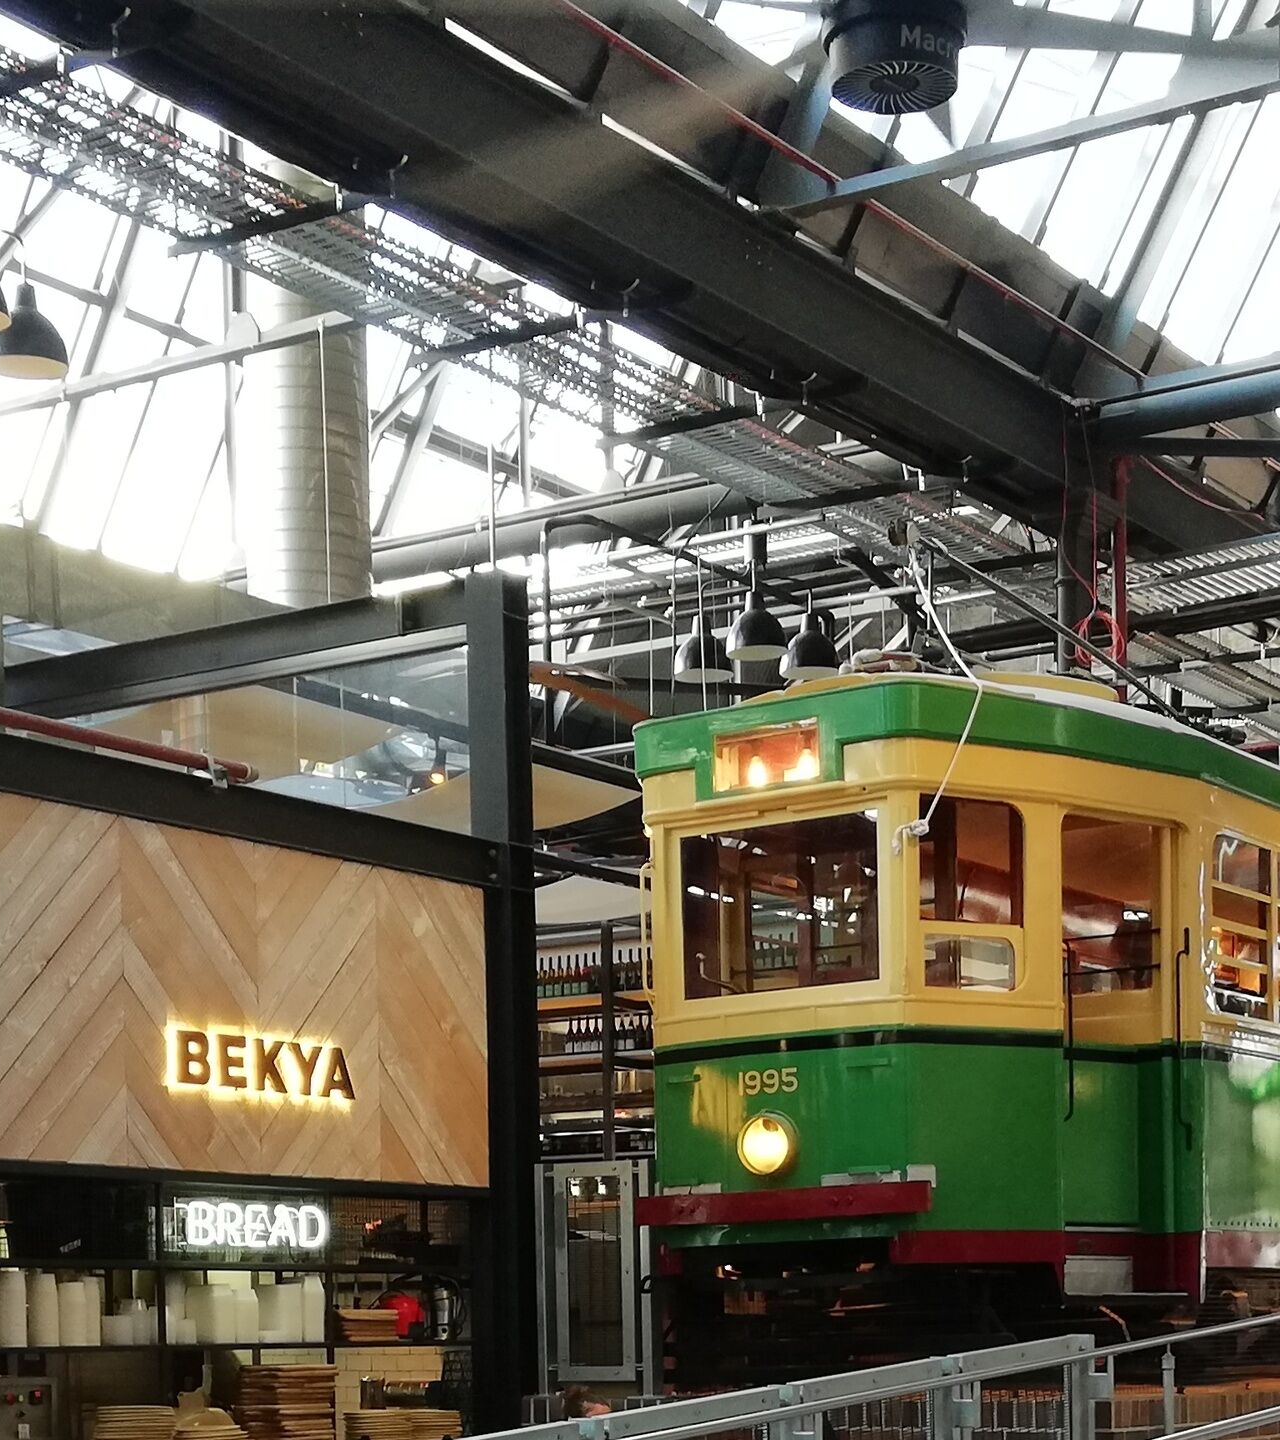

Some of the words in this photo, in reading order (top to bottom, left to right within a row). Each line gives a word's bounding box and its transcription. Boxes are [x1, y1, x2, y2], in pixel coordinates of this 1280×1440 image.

[175, 1029, 356, 1101] BEKYA
[738, 1066, 799, 1097] 1995
[186, 1201, 326, 1248] BREAD
